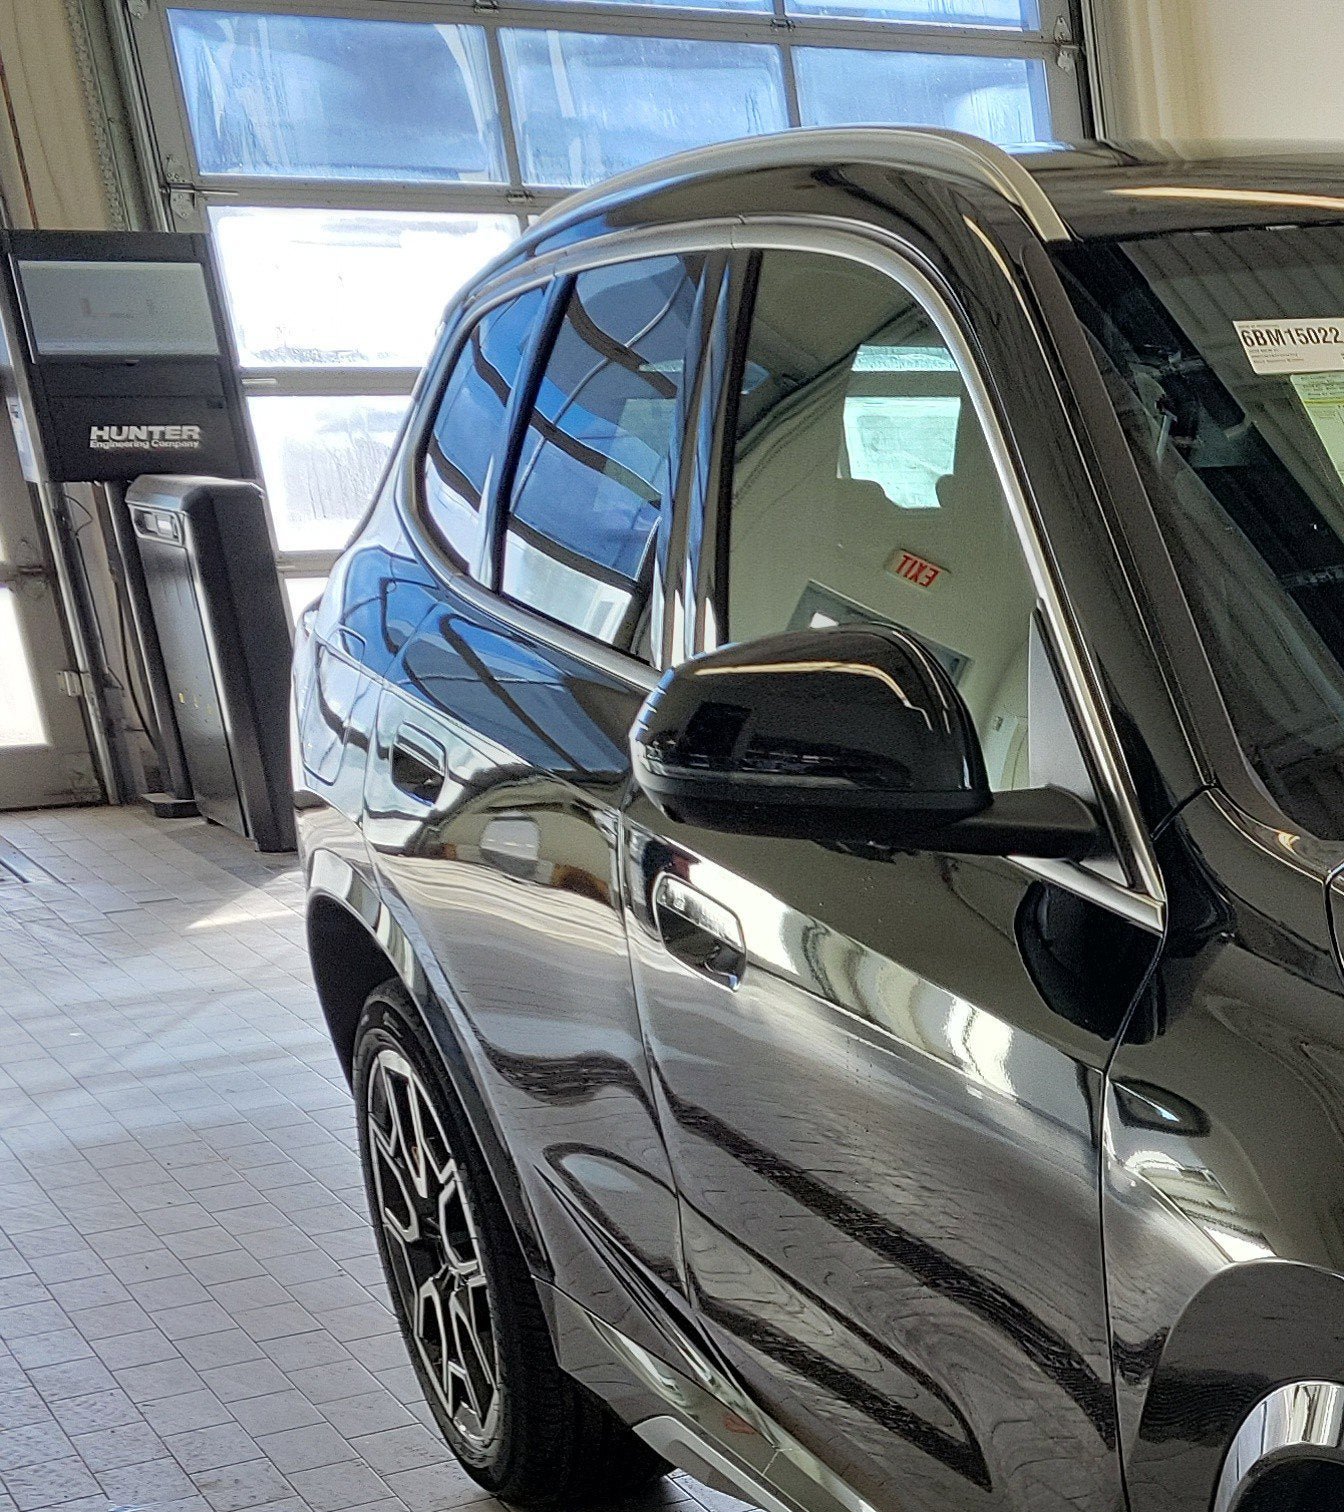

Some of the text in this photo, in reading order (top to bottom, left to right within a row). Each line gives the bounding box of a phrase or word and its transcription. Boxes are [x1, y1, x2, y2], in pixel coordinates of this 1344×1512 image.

[1241, 327, 1344, 347] 6BM15022
[90, 425, 200, 440] HUNTER
[90, 440, 199, 449] Engineering Company
